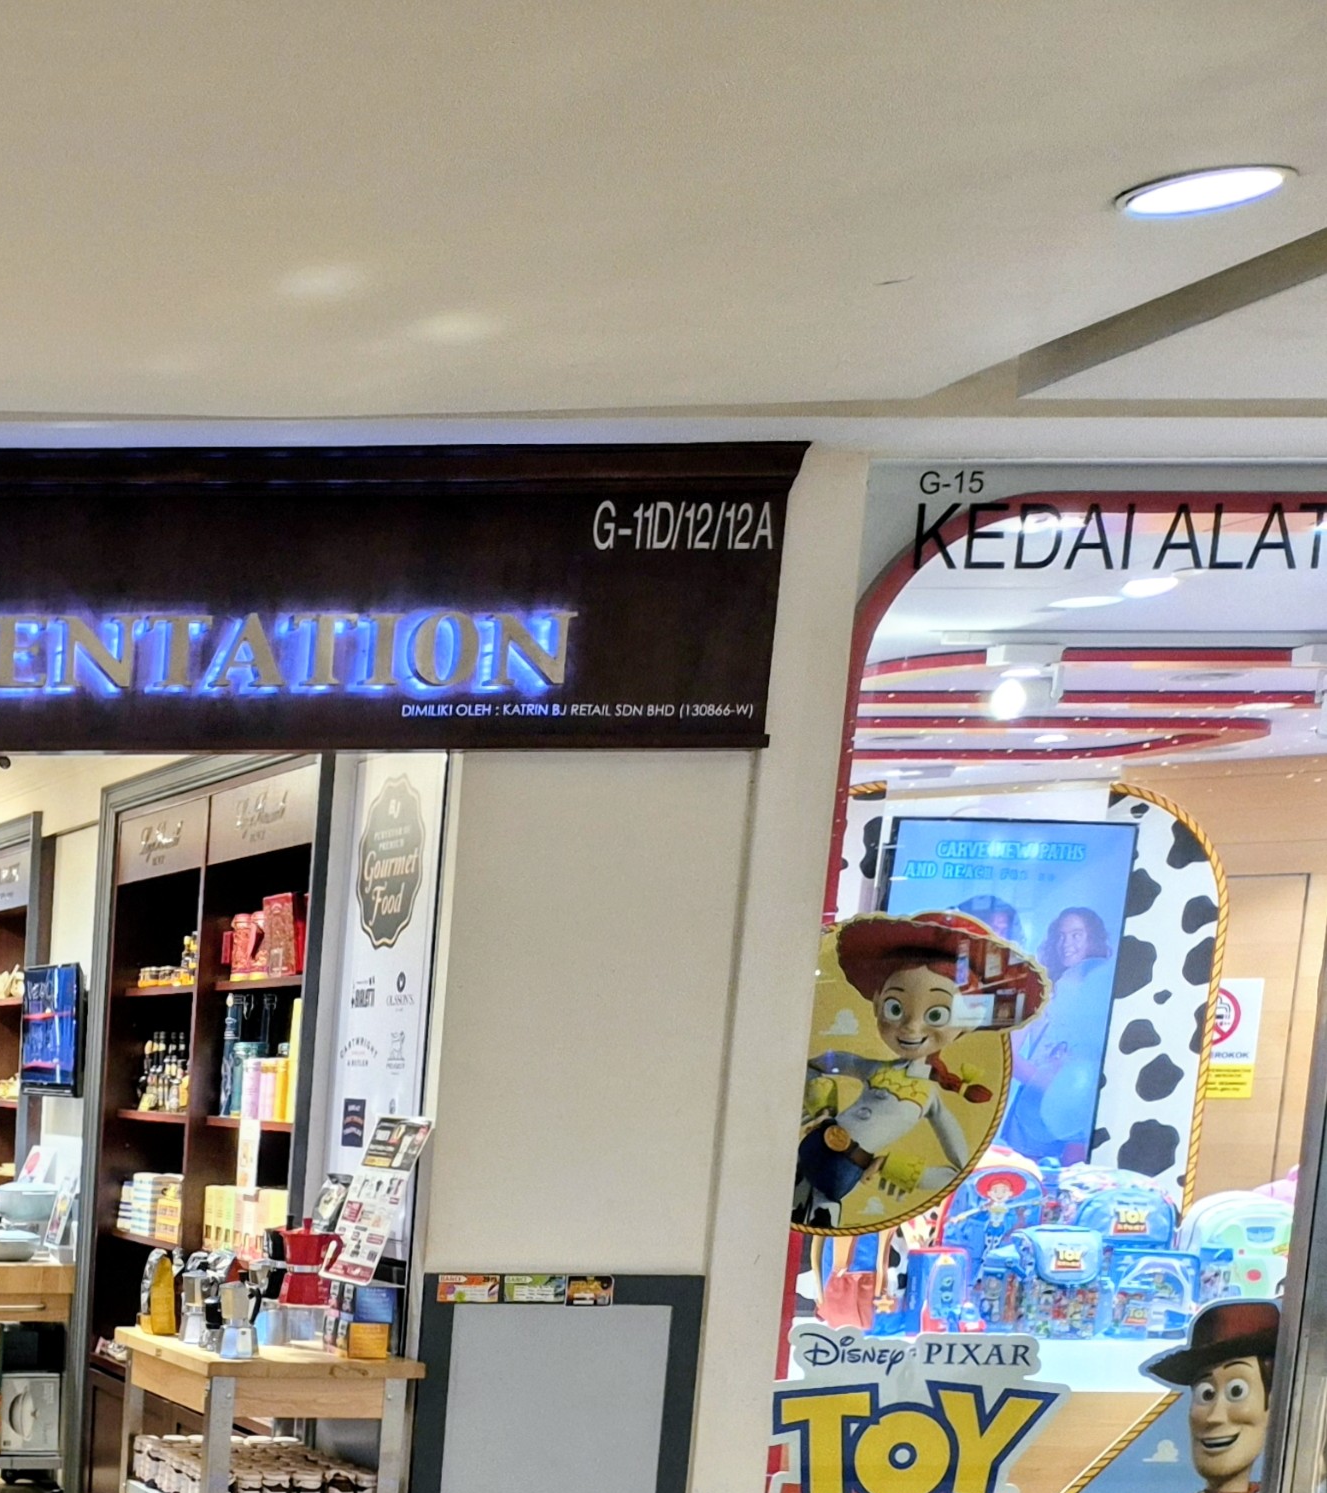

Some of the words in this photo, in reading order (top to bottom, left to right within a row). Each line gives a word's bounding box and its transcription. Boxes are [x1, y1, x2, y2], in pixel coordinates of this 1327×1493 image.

[918, 470, 985, 495] G-15
[592, 499, 774, 551] G-11D/12/12A
[912, 502, 1136, 571] KEDAI
[401, 703, 453, 717] DIMILIKI
[455, 703, 492, 717] OLEH
[502, 703, 549, 717] KATRIN
[551, 703, 568, 717] BJ
[570, 704, 612, 717] RETAIL
[614, 703, 643, 717] SDN
[646, 703, 675, 717] BHD
[678, 703, 754, 719] (130866-W)
[935, 840, 989, 858] CARVE
[1038, 842, 1086, 862] PATHS
[363, 848, 419, 894] Gourmet
[904, 860, 938, 879] AND
[369, 882, 406, 927] Food
[1115, 1208, 1152, 1224] TOY
[1057, 1247, 1085, 1261] TOY
[799, 1333, 905, 1375] Disney
[923, 1341, 1032, 1368] PIXAR
